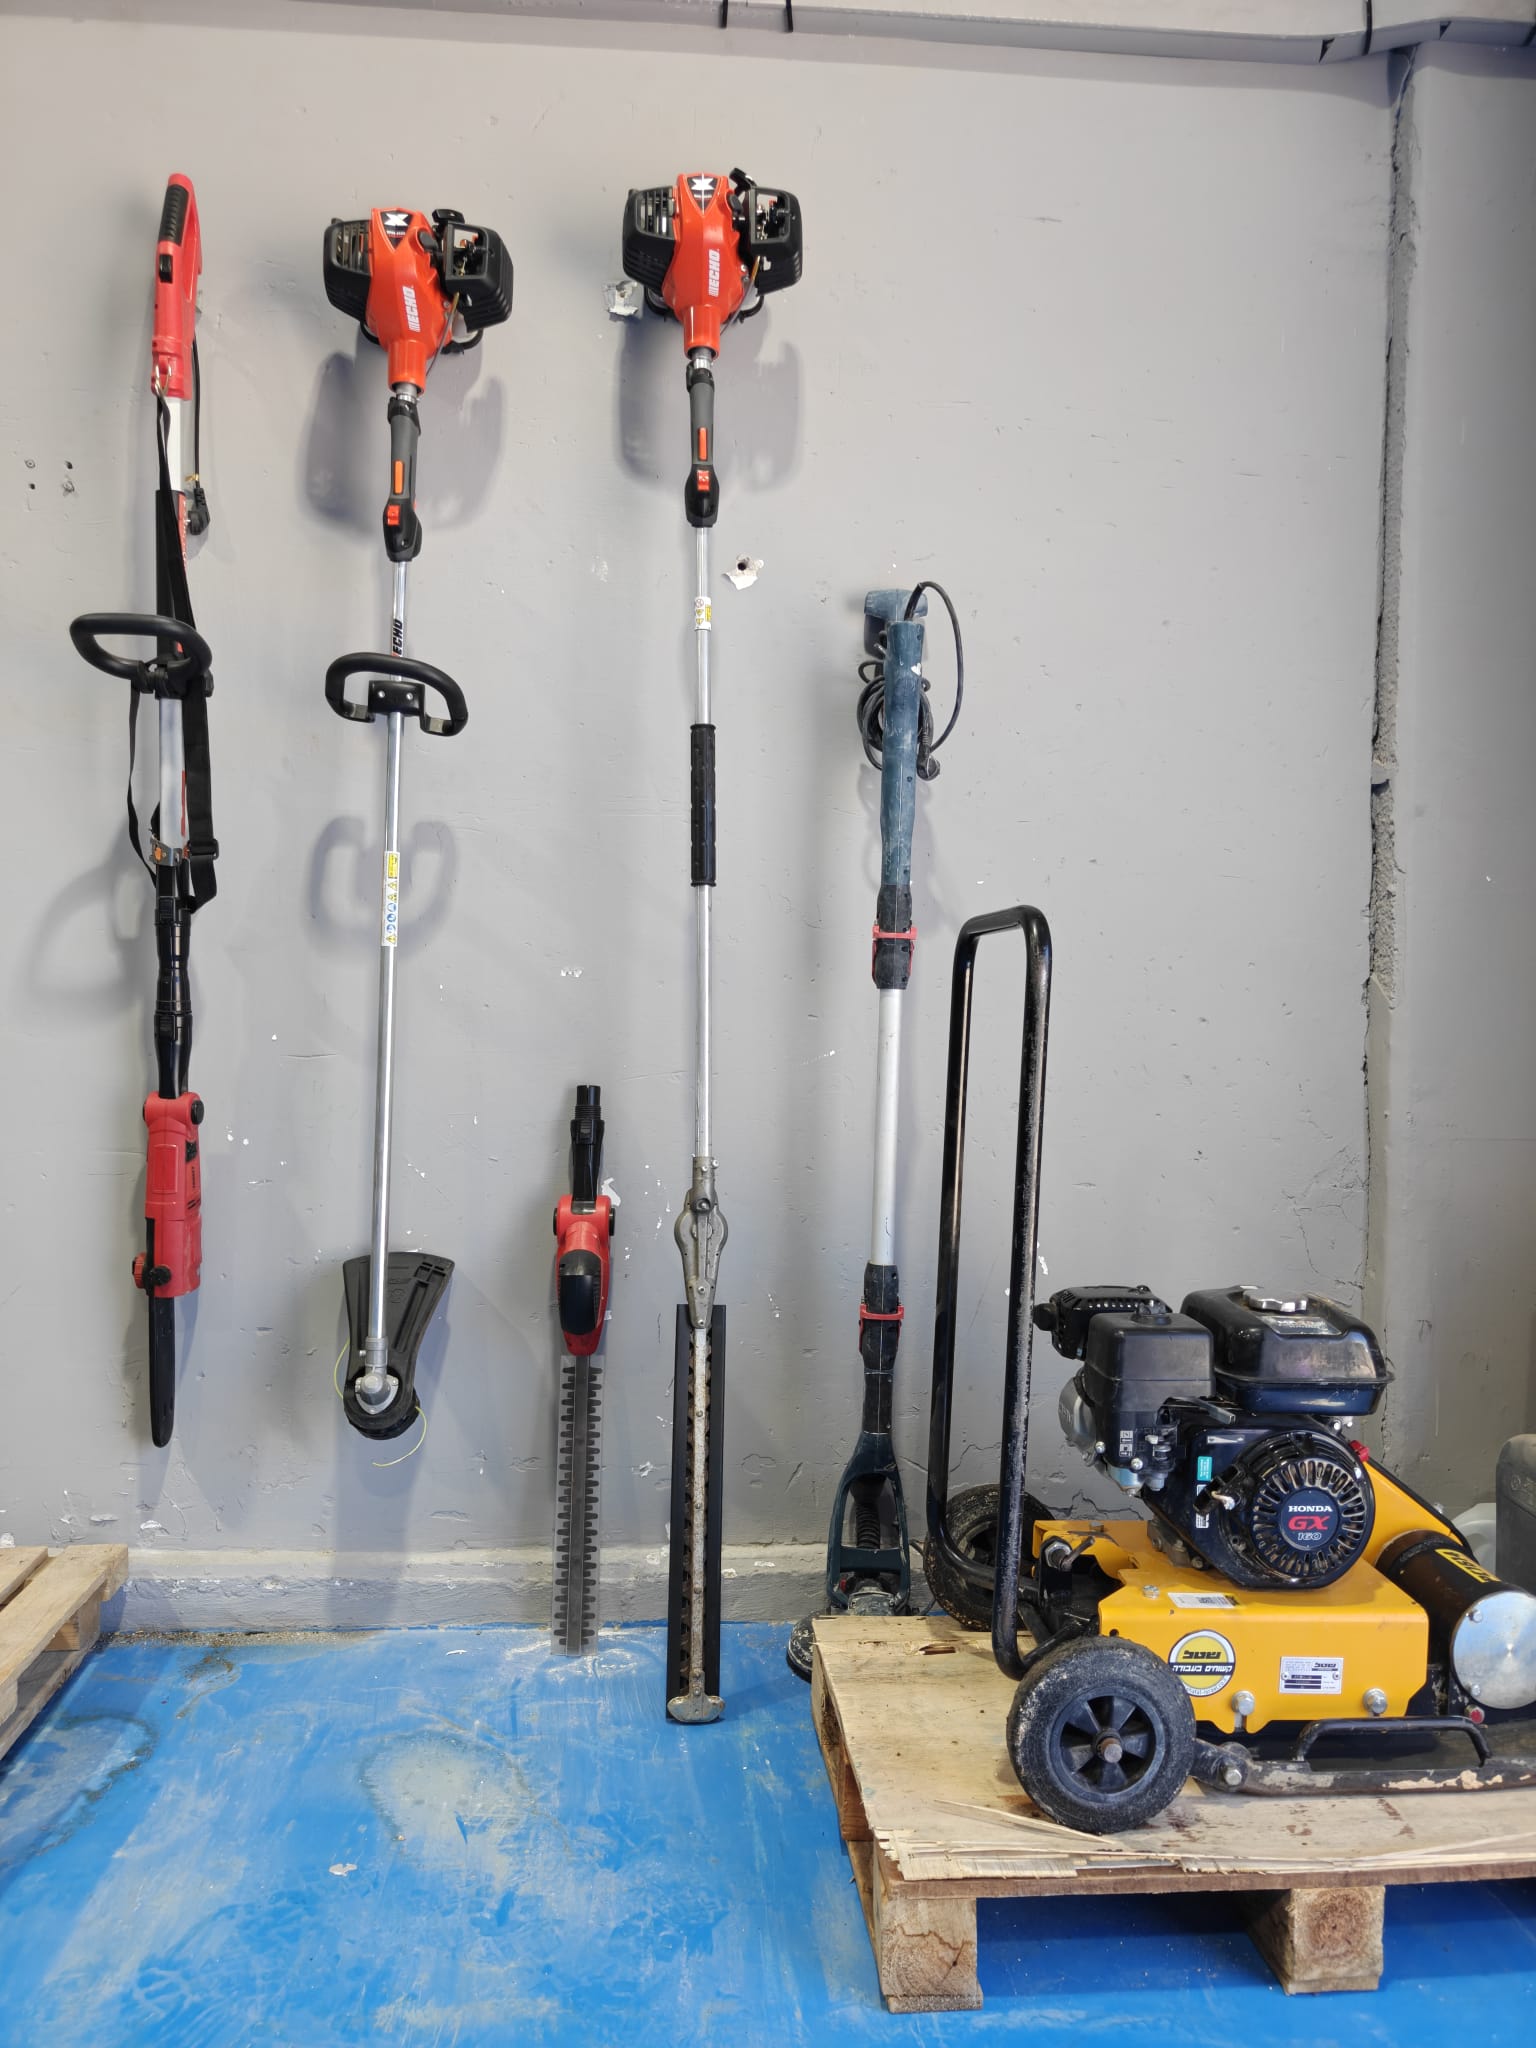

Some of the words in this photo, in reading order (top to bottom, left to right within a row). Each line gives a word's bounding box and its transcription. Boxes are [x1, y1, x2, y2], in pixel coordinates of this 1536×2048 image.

[708, 249, 720, 294] ECHO
[402, 285, 420, 329] ECHO
[392, 618, 403, 656] ECHO
[1288, 1505, 1333, 1513] HONDA
[1288, 1515, 1330, 1530] GX
[1297, 1532, 1322, 1541] 160
